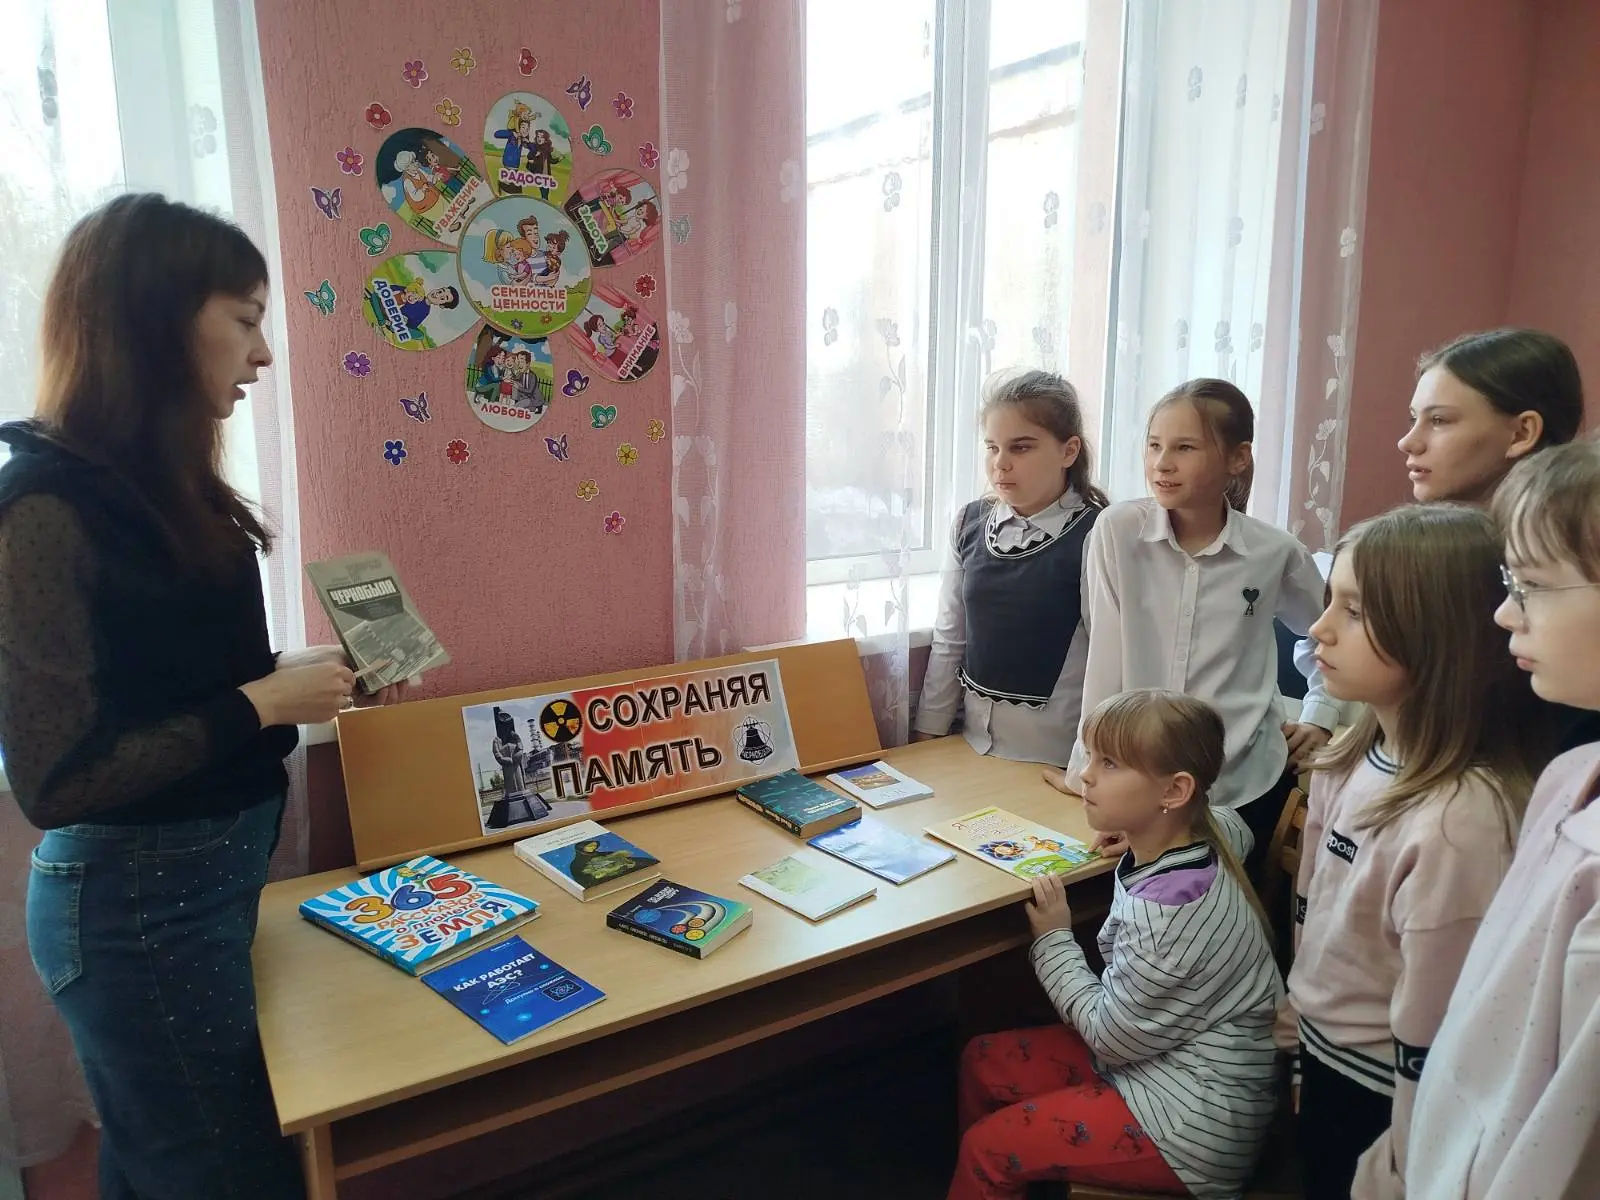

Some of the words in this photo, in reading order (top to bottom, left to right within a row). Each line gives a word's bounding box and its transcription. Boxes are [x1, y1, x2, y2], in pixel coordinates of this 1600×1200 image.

[500, 170, 557, 188] РАДОСТЬ
[434, 177, 480, 234] УВАЖЕНИЕ
[579, 205, 607, 252] ЗАБОТА
[373, 279, 410, 342] ДОВЕРИЕ
[491, 284, 566, 299] СЕМЕЙНЫЕ
[493, 299, 565, 311] ЦЕННОСТИ
[618, 325, 655, 377] ВНИМАНИЕ
[480, 402, 532, 420] ЛЮБОВЬ
[329, 579, 397, 605] ЧЕРНОБЫЛЯ
[588, 672, 770, 731] СОХРАНЯЯ
[552, 738, 722, 798] ПАМЯТЬ
[345, 873, 473, 923] 365
[377, 892, 482, 930] РАССКАЗОВ
[396, 900, 507, 949] ЗЕМЛЯ
[453, 977, 479, 992] КАК
[480, 953, 536, 981] РАБОТАЕТ
[487, 969, 523, 989] АЭС?
